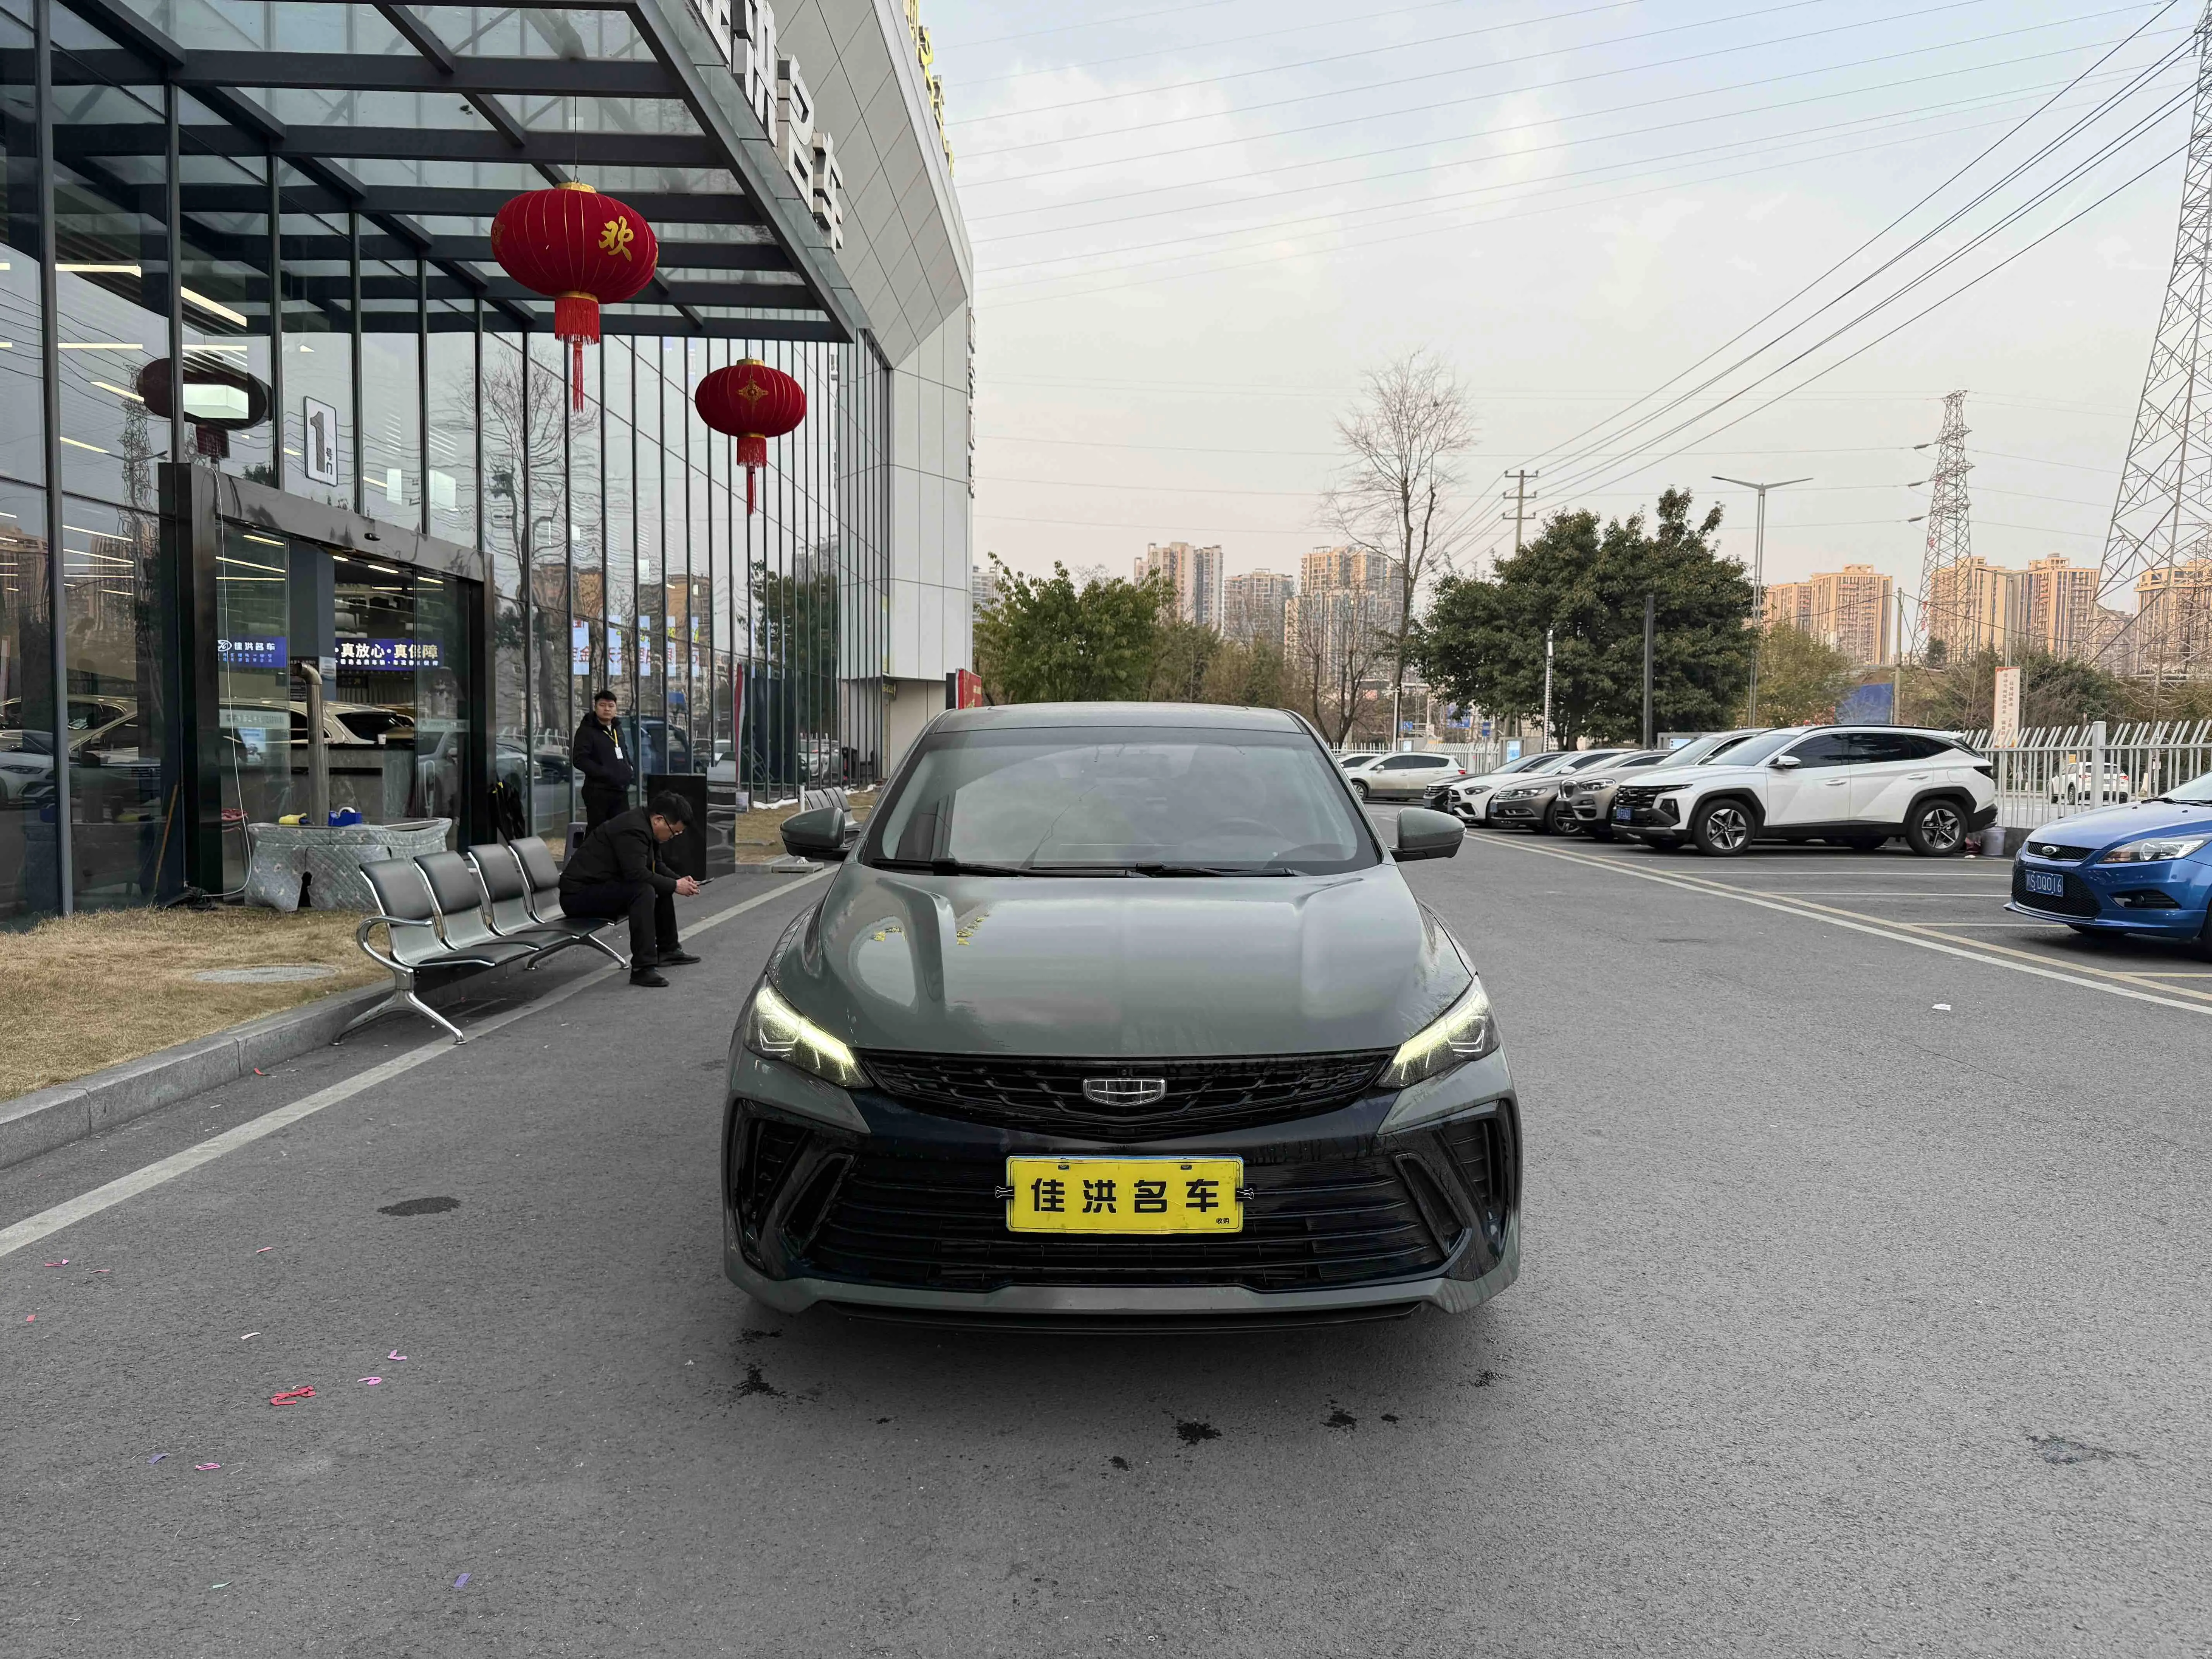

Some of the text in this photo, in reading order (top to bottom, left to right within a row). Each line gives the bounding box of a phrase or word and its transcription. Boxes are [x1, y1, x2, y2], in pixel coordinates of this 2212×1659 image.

[598, 216, 634, 261] 欢
[1031, 1178, 1219, 1213] 佳洪名车
